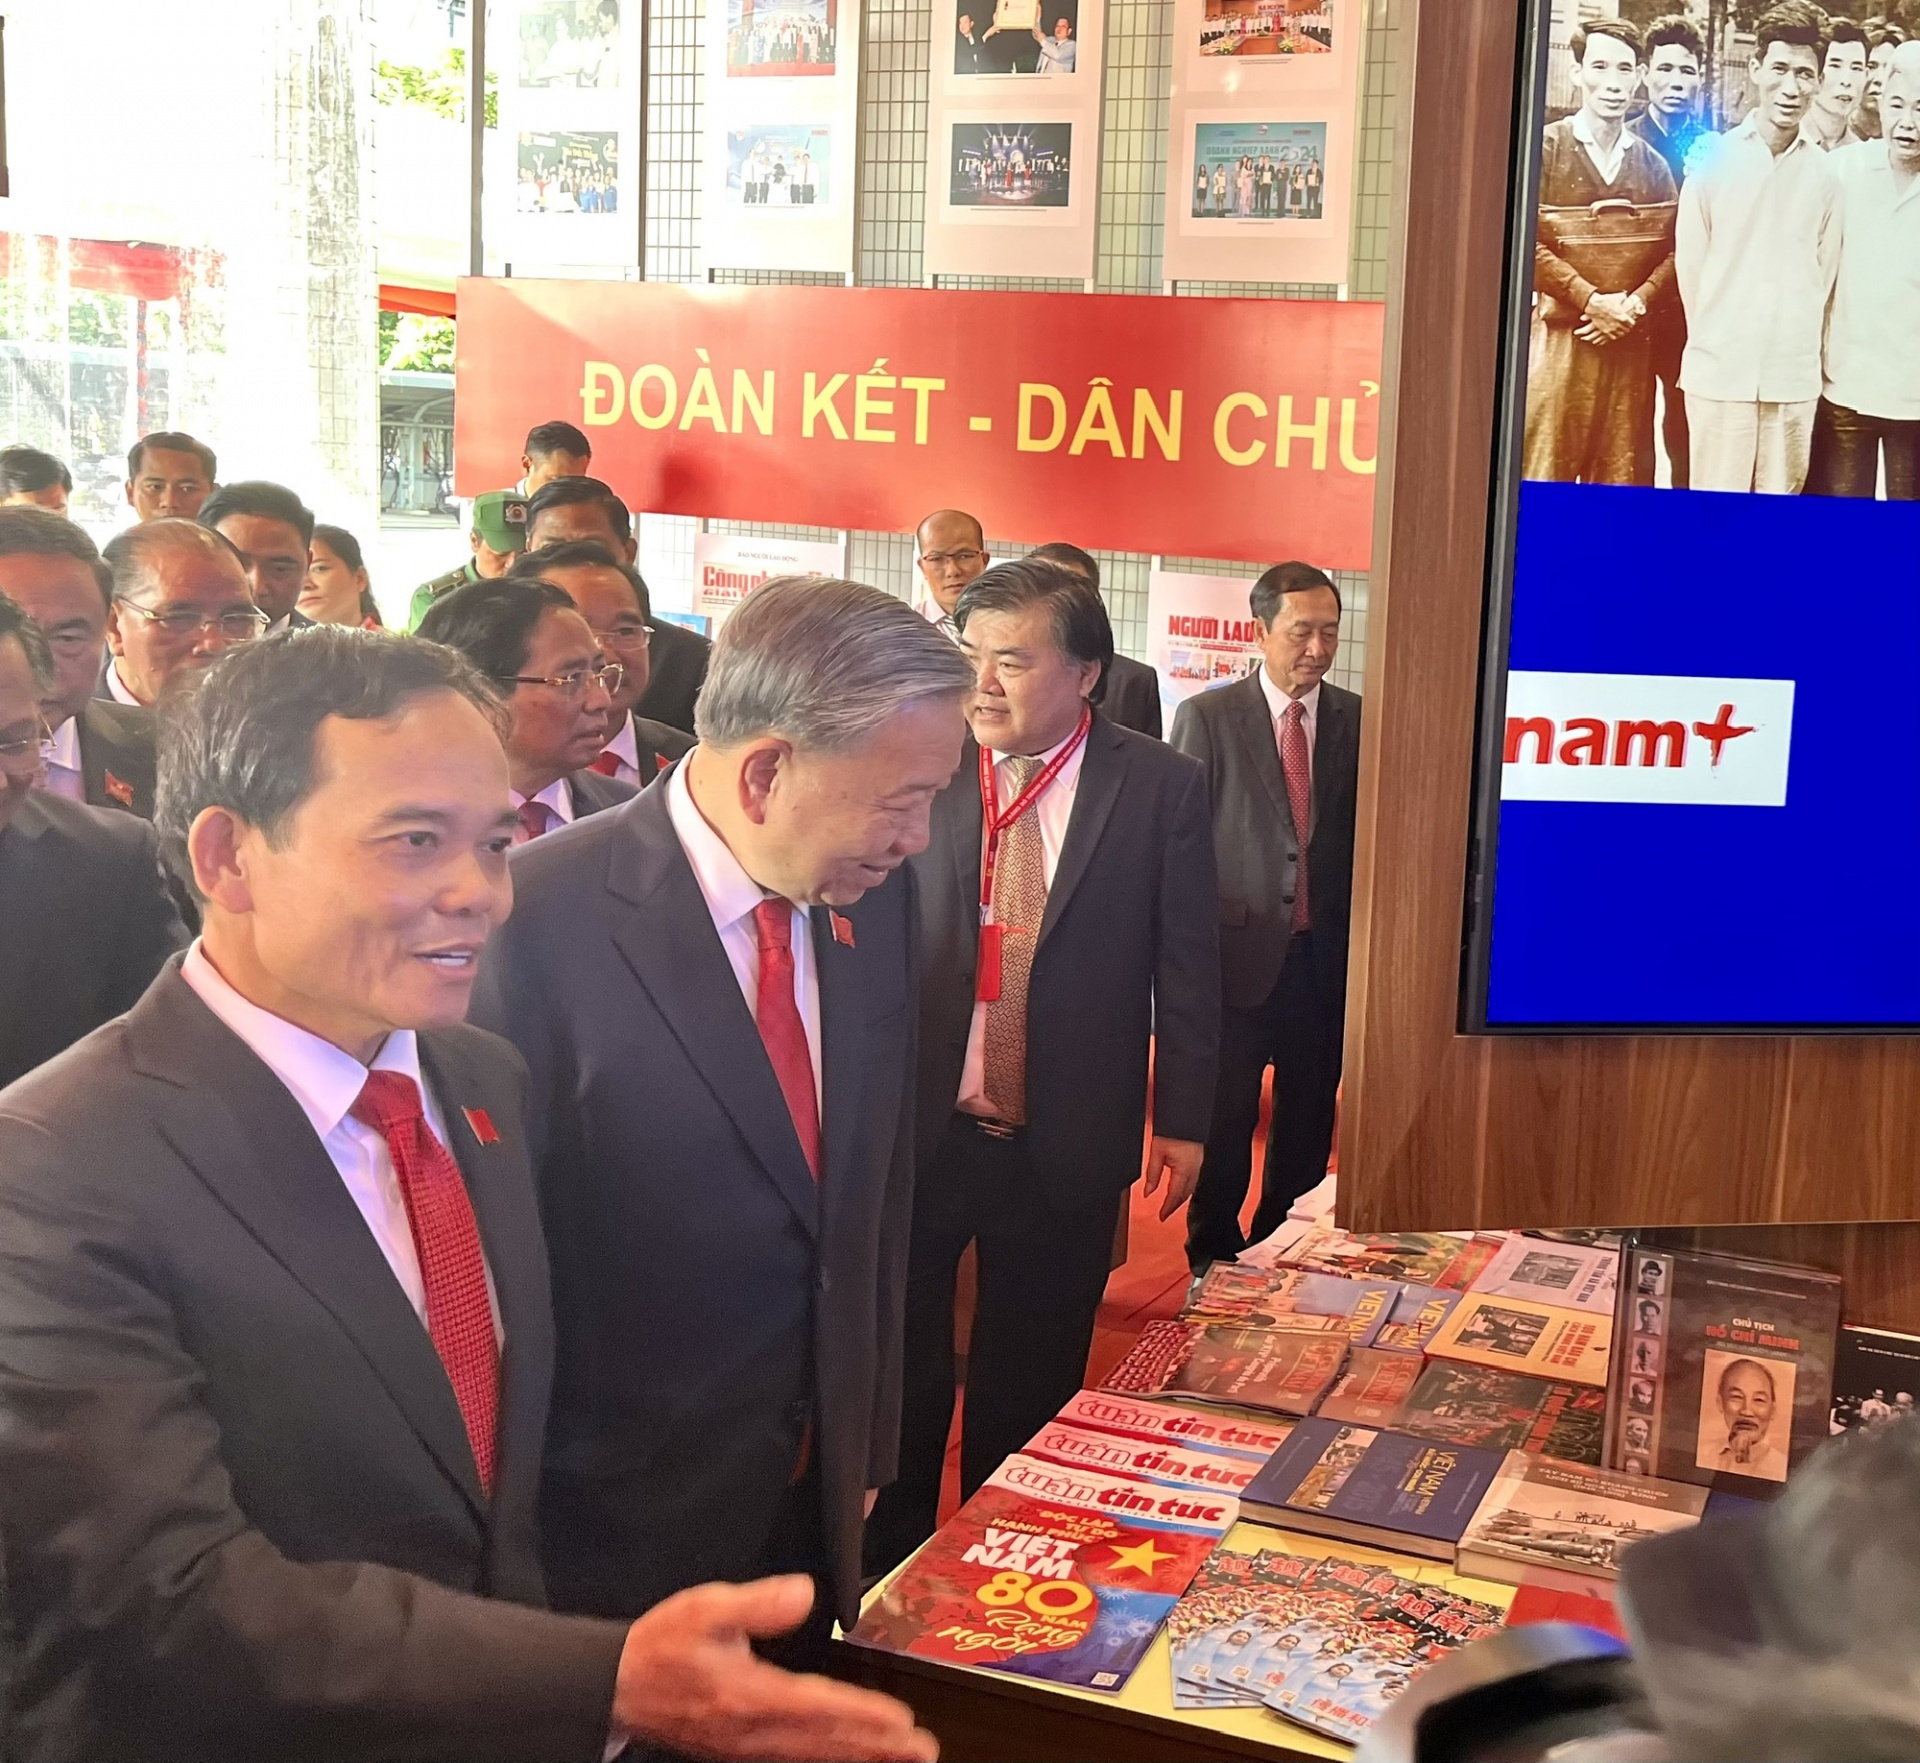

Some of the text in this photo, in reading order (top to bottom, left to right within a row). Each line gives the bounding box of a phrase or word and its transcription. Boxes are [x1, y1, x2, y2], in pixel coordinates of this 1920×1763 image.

[580, 349, 1380, 474] ĐOÀN KẾT - DÂN CHỦ
[703, 566, 749, 591] Công
[1223, 620, 1254, 642] LAO
[1733, 1316, 1775, 1332] CHỦ TỊCH
[1758, 1334, 1799, 1350] MINH
[1163, 1416, 1216, 1438] tin
[1132, 1450, 1187, 1475] tin
[1433, 1452, 1458, 1472] VIỆT
[1416, 1470, 1447, 1496] NAM
[1097, 1487, 1155, 1512] tin
[1158, 1498, 1226, 1522] tức
[984, 1527, 1080, 1559] VIỆT
[1089, 1528, 1118, 1538] DO
[961, 1544, 1075, 1580] NAM
[1264, 1557, 1317, 1579] 越
[976, 1571, 1093, 1616] 80
